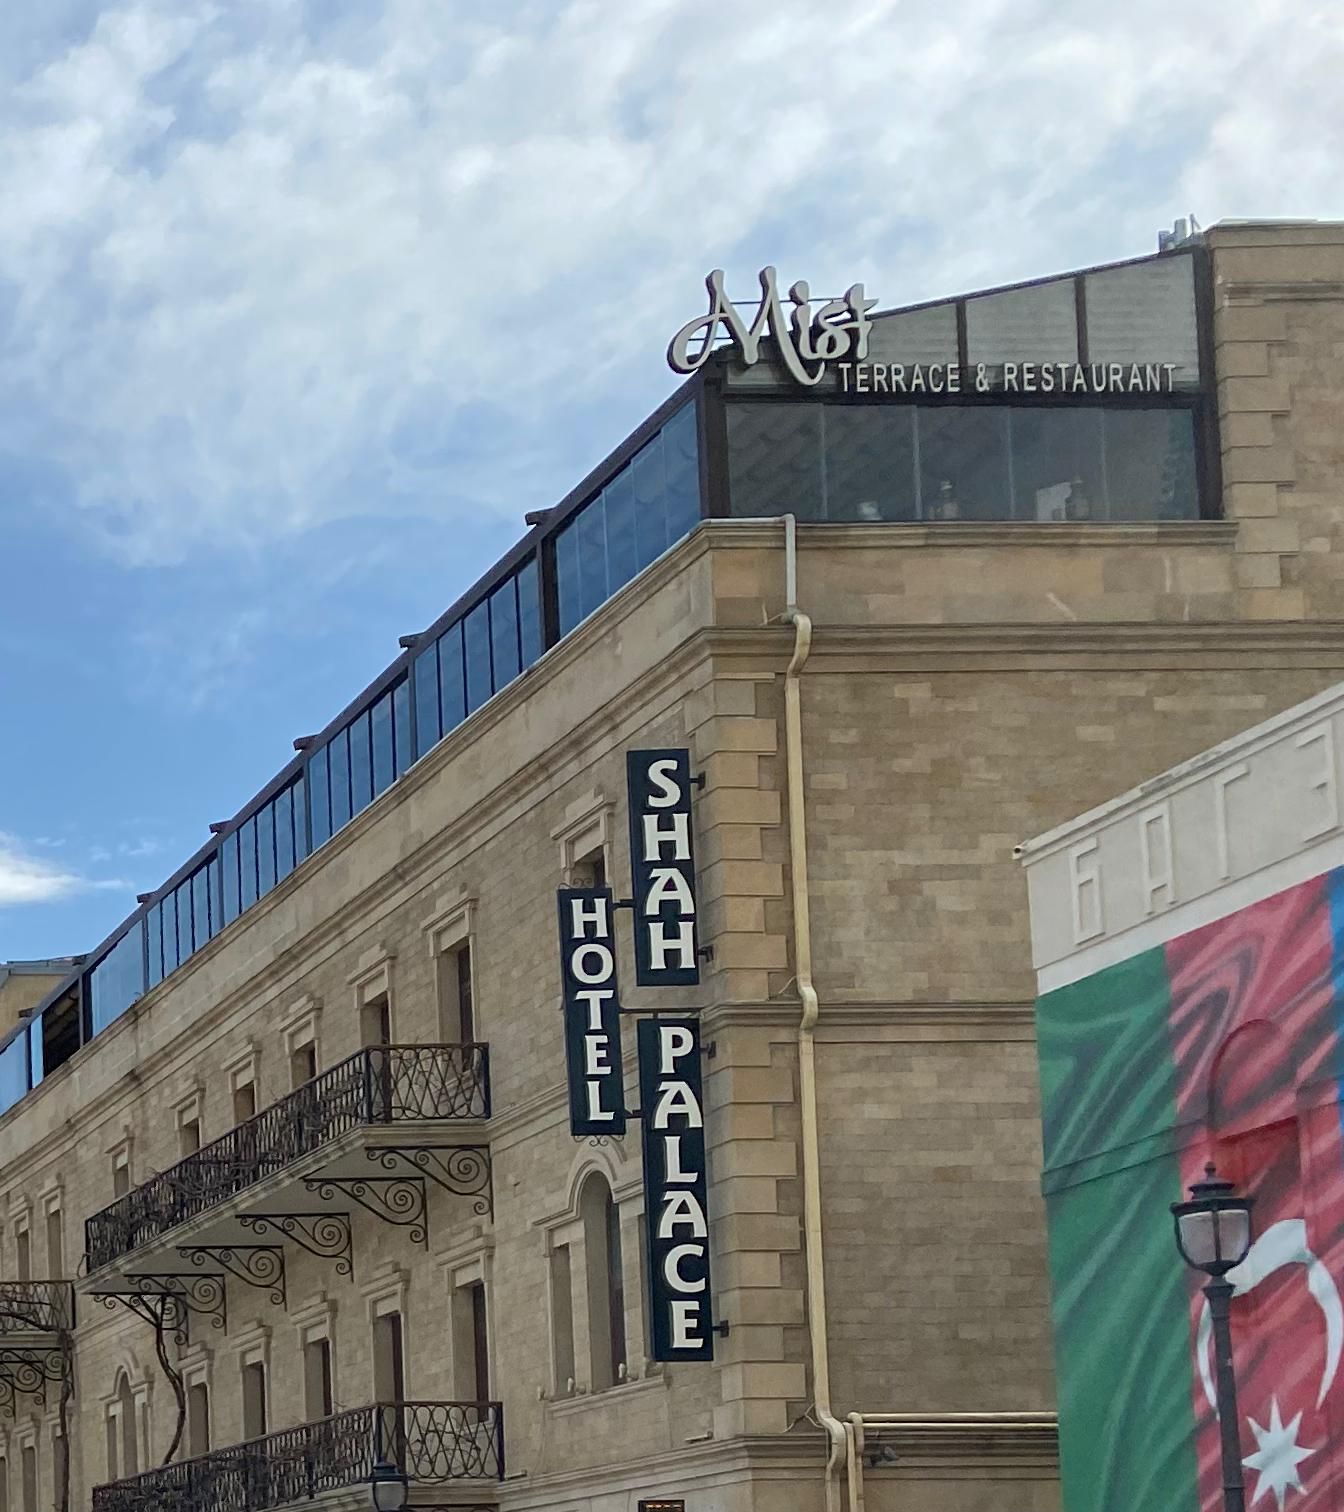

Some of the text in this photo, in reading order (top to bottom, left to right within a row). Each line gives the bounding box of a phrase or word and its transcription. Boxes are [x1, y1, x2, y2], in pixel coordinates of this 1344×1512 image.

[667, 265, 880, 386] Mist
[838, 361, 1178, 393] TERRACE & RESTAURANT
[642, 759, 696, 971] SHAH
[570, 896, 615, 1122] HOTEL
[653, 1025, 708, 1350] PALACE
